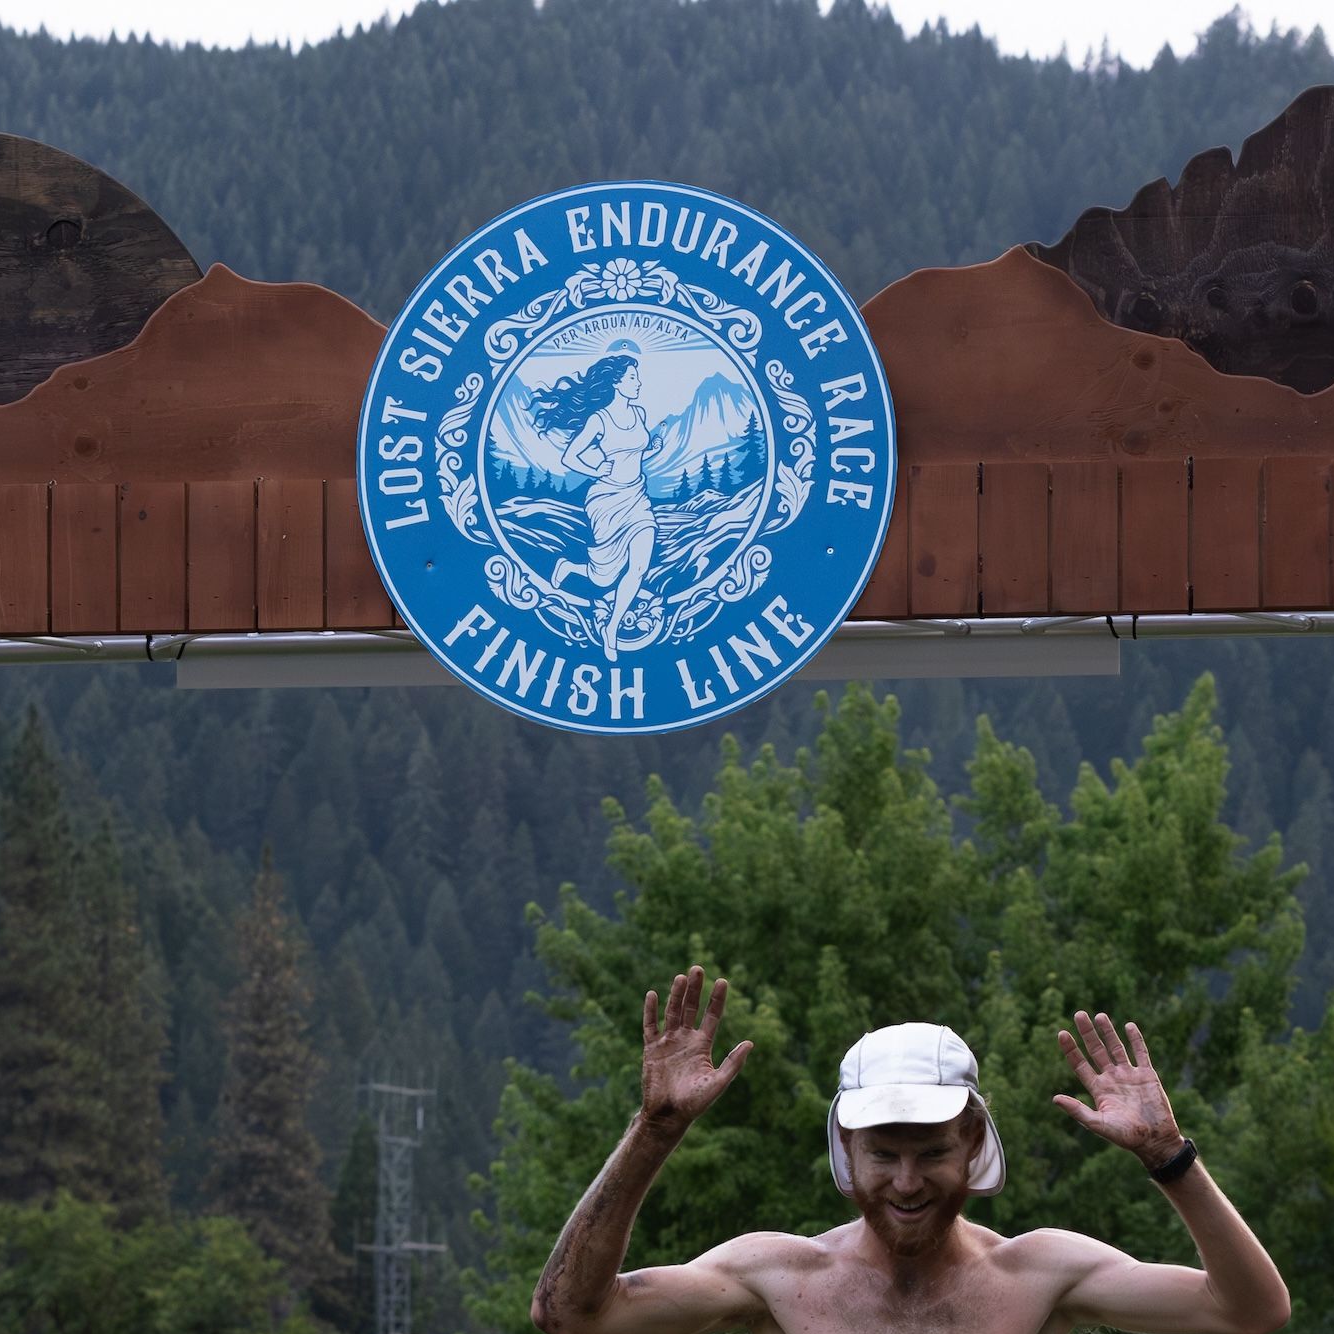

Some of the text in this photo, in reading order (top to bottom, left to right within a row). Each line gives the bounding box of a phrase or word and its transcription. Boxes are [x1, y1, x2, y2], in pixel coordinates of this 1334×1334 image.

[377, 200, 876, 530] LOST SIERRA ENDURANCE RACE
[552, 316, 690, 349] PER ARDUA AD ALTA
[443, 593, 816, 720] FINISH LINE
